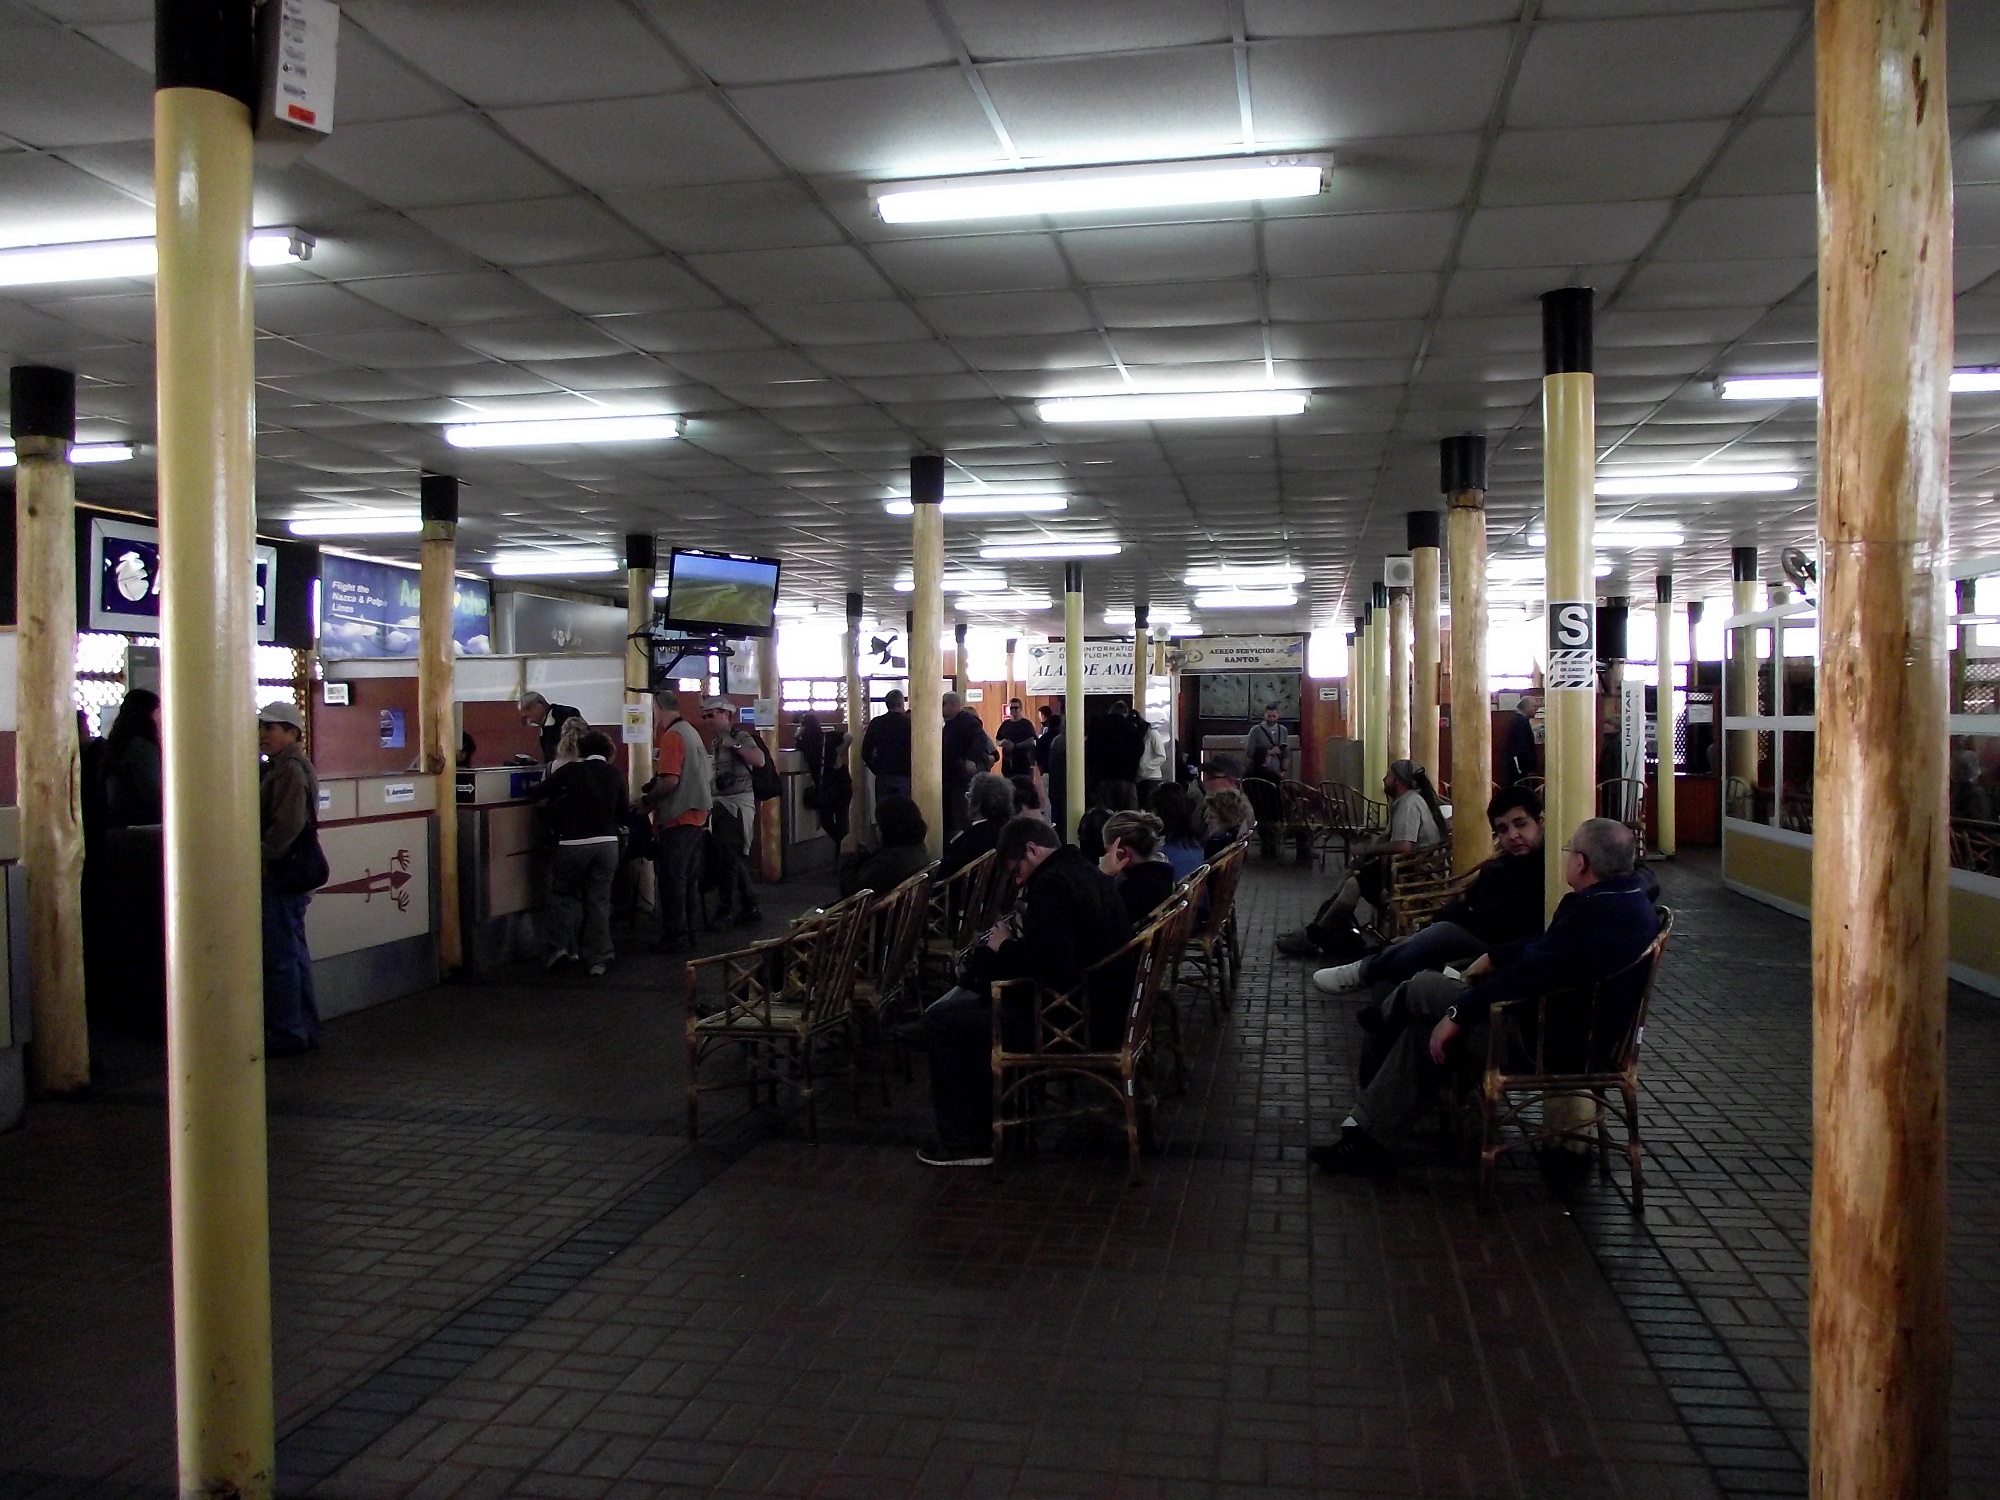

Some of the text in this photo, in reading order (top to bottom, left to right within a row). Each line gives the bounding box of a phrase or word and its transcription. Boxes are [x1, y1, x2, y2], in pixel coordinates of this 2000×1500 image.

[332, 580, 370, 594] Flight the
[332, 603, 354, 614] Lines
[1559, 606, 1588, 645] S
[1033, 663, 1066, 677] ALA
